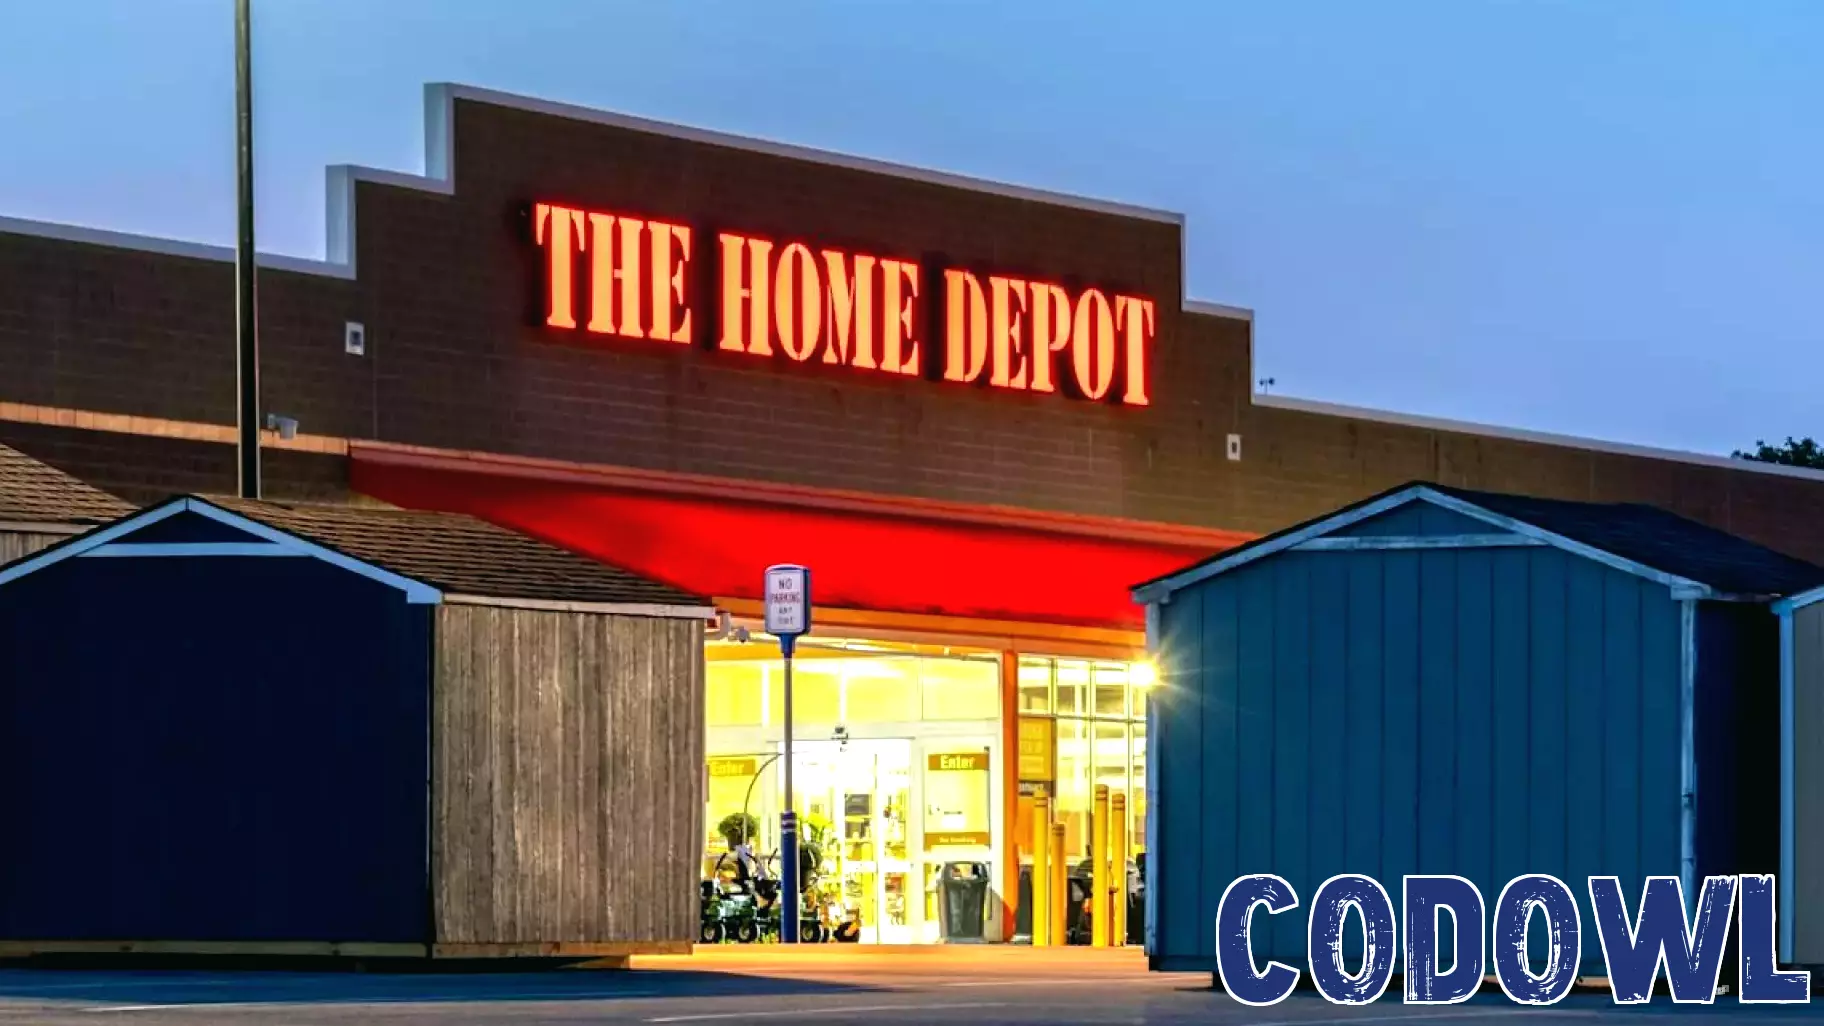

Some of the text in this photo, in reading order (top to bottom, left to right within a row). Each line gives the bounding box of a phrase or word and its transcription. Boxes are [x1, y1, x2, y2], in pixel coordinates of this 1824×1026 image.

[535, 203, 1154, 406] THE HOME DEPOT
[778, 578, 793, 590] NO
[940, 754, 976, 769] Enter
